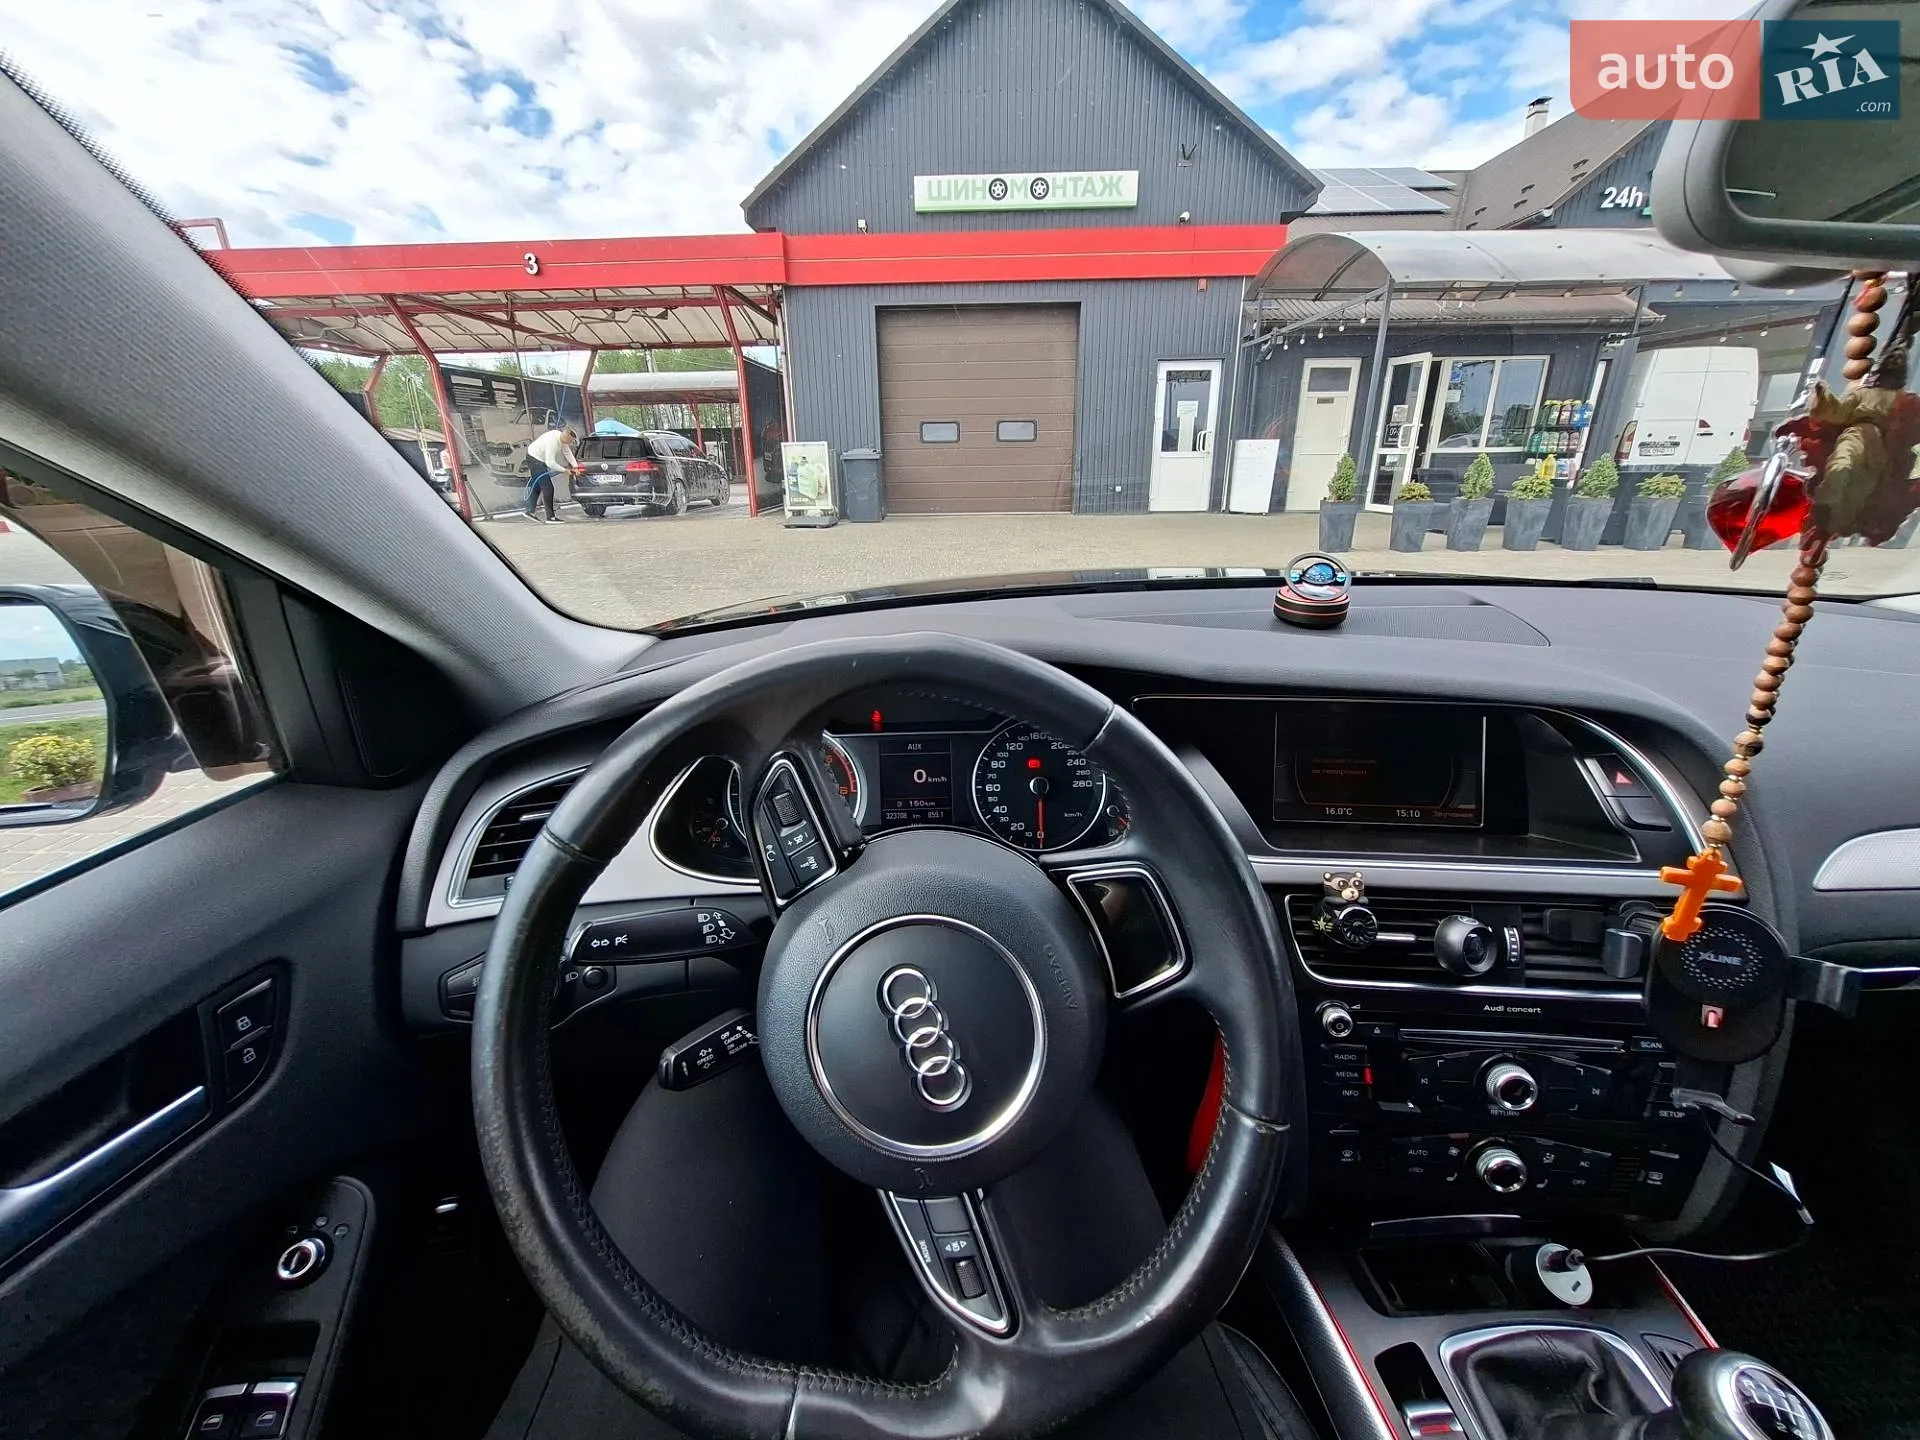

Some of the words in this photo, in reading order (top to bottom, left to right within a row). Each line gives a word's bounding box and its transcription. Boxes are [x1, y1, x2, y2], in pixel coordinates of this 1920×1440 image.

[927, 175, 1124, 202] ШИНОМОНТАЖ
[1600, 186, 1643, 209] 24h
[523, 252, 539, 275] 3
[913, 769, 927, 783] 0
[1324, 807, 1353, 816] 16.0°C
[1396, 809, 1421, 818] 15:10
[1483, 1004, 1505, 1012] Audi
[1506, 1005, 1542, 1014] concert
[721, 1031, 730, 1040] OFF
[724, 1033, 743, 1045] CANCEL
[1640, 1041, 1663, 1049] SCAN
[697, 1054, 714, 1065] SPEED
[1335, 1070, 1359, 1078] MEDIA
[1342, 1089, 1359, 1097] INFO
[1658, 1110, 1686, 1118] SETUP
[919, 1240, 931, 1263] MODE
